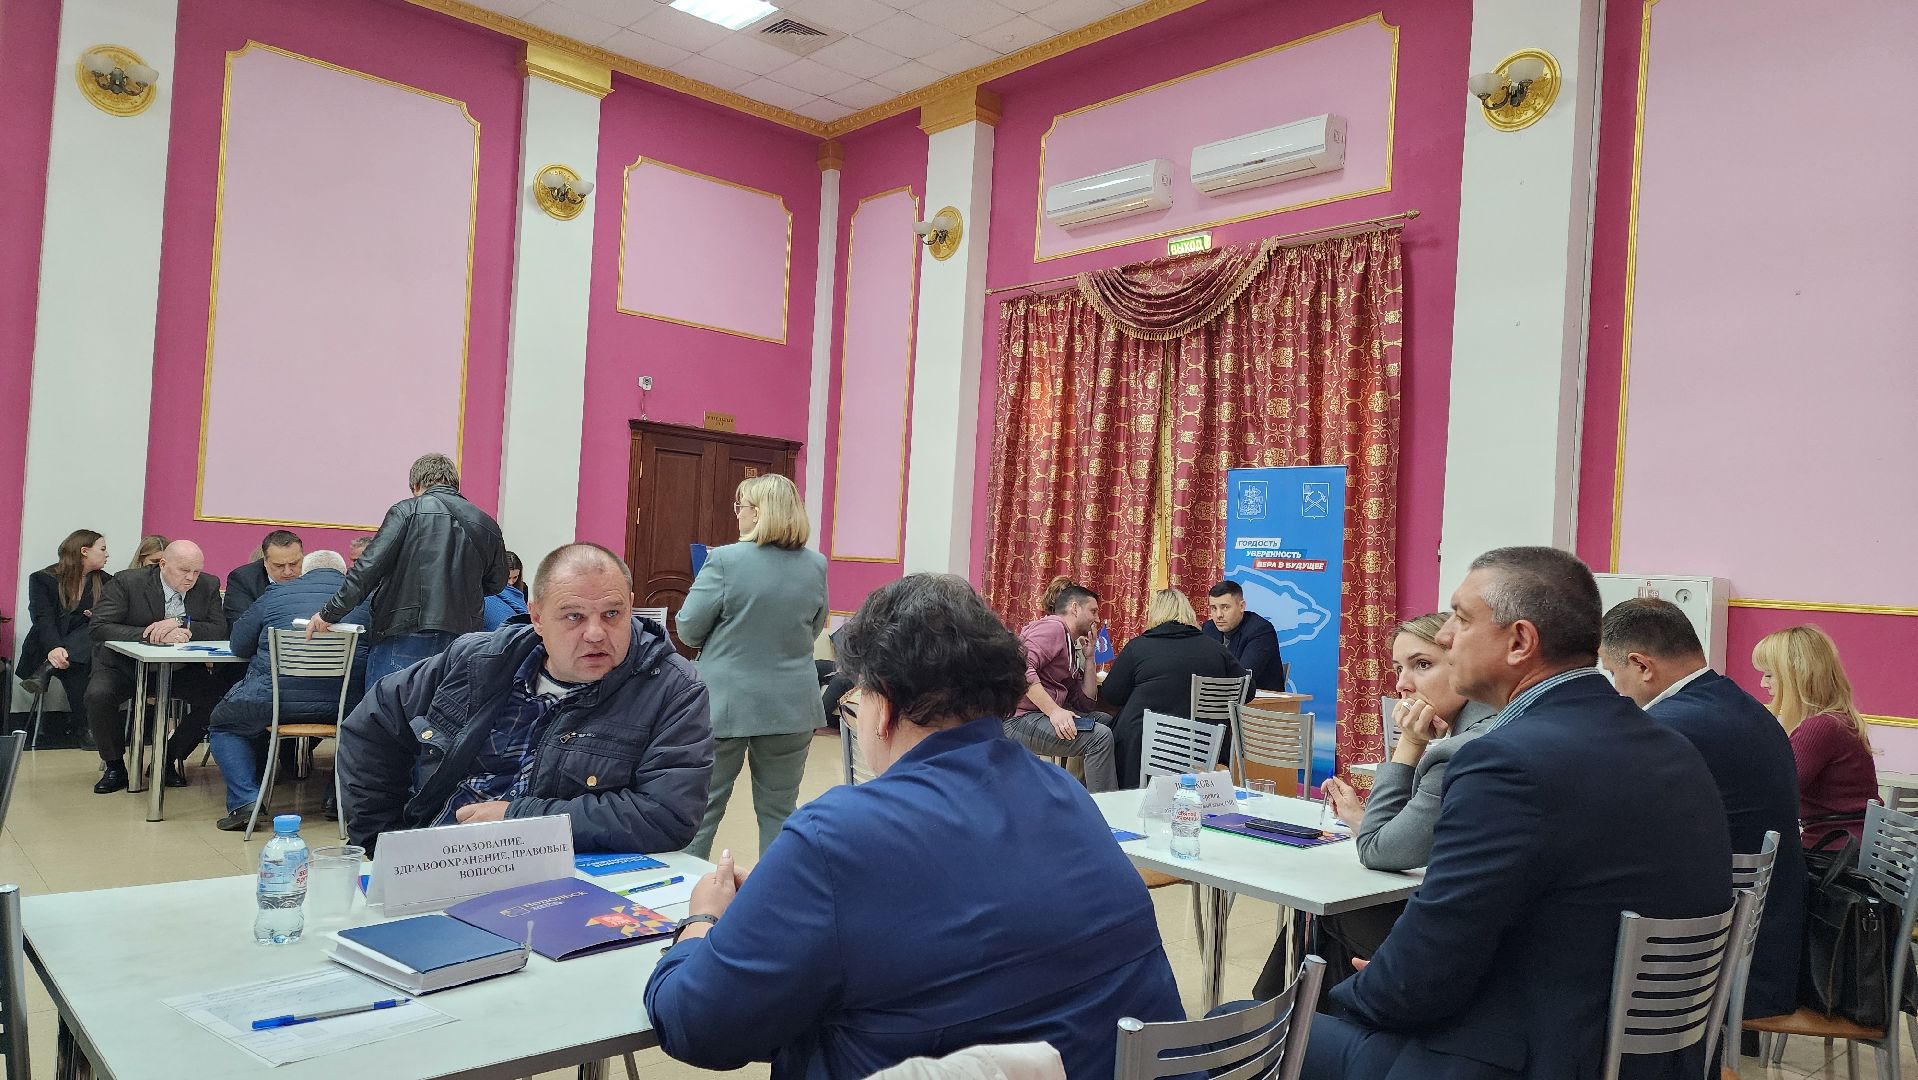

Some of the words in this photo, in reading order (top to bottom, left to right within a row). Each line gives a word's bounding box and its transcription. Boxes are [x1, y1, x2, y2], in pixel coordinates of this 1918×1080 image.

[1170, 239, 1204, 255] ВЫХОД
[1245, 550, 1302, 559] УВЕРЕННОСТЬ
[1256, 561, 1277, 569] ВЕРА
[1285, 562, 1325, 571] БУДУЩЕЕ
[393, 851, 510, 876] ЗДРАВООХРАНЕНИЕ,
[512, 843, 569, 860] ПРАВОВЫЕ
[459, 863, 515, 879] ВОПРОСЫ
